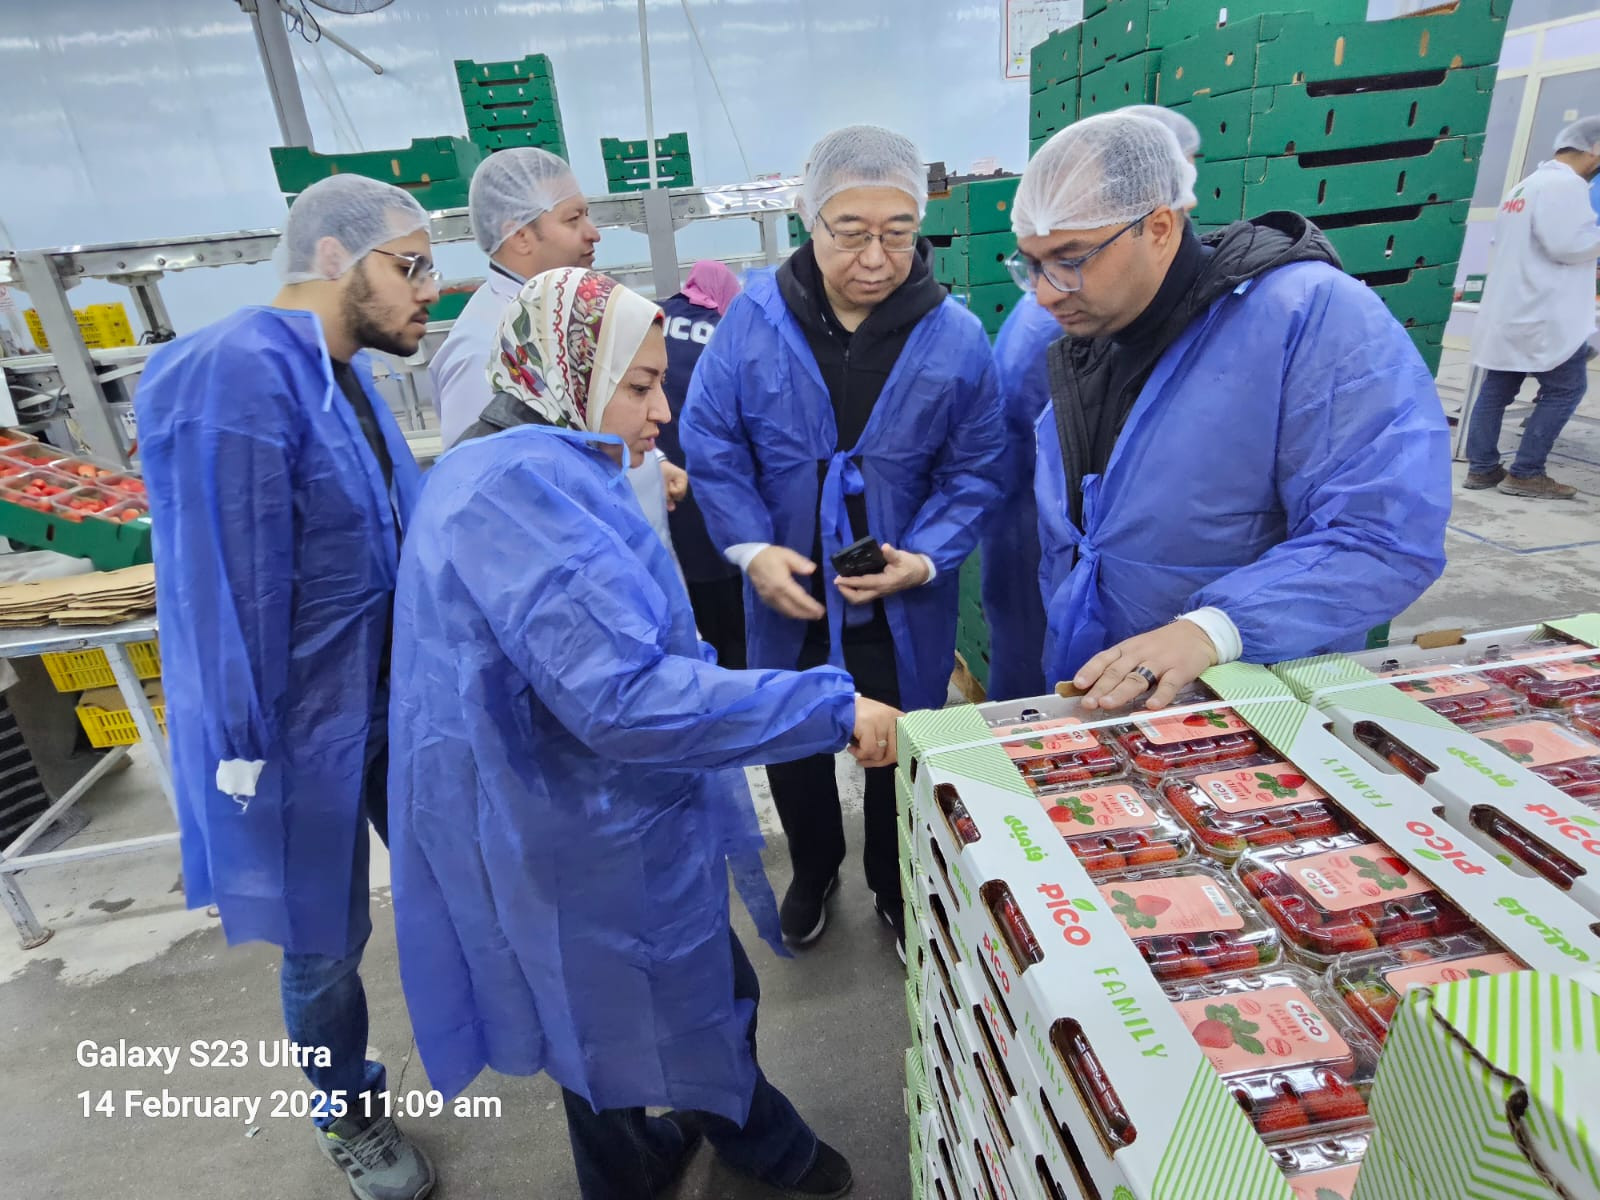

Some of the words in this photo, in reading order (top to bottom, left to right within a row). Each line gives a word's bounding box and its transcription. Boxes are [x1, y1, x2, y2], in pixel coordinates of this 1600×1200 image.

[663, 316, 715, 345] ICO
[1320, 757, 1393, 808] FAMILY
[1406, 820, 1488, 876] PICO
[1523, 803, 1600, 856] PICO
[1036, 883, 1091, 946] PICO
[982, 931, 1010, 994] PICO
[983, 993, 1008, 1057] PICO
[1094, 967, 1168, 1058] FAMILY
[1291, 1004, 1322, 1037] PICO
